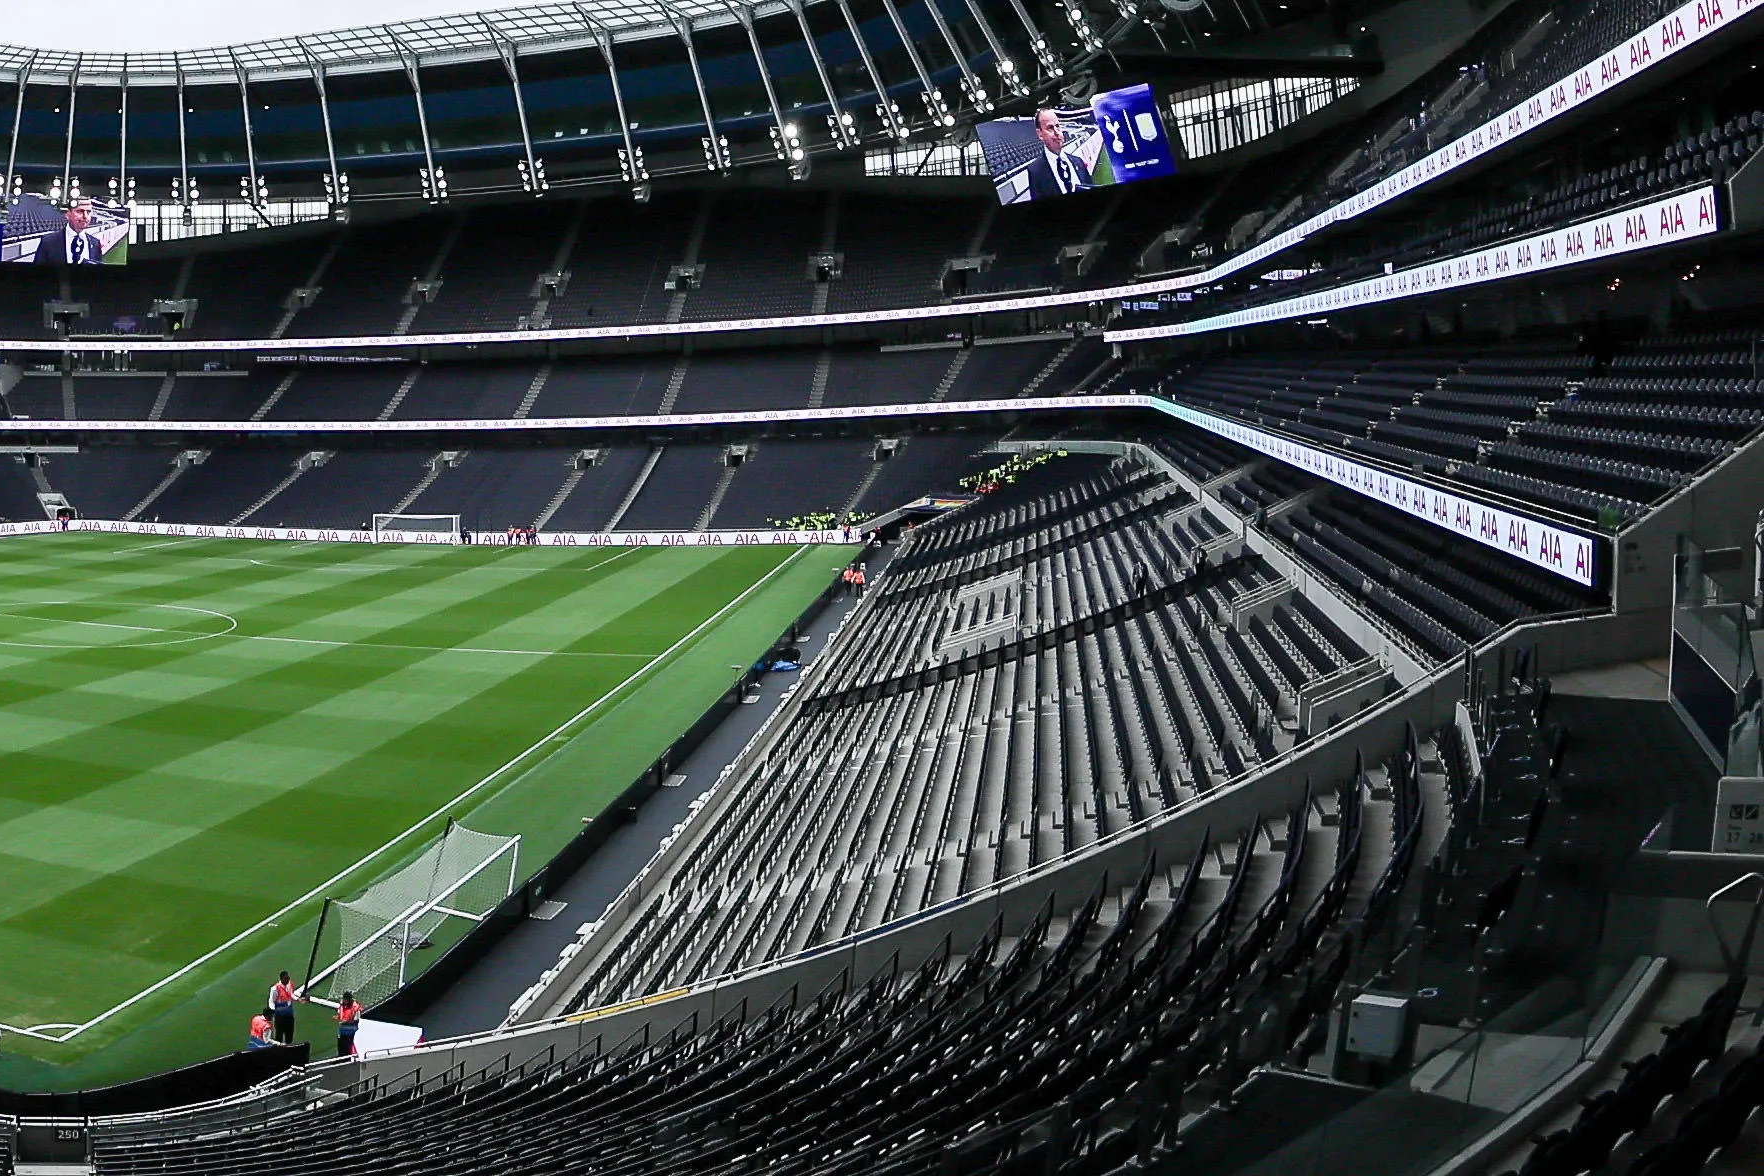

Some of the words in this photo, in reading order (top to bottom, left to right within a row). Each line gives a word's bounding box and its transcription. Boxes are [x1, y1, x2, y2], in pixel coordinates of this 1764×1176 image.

[1574, 70, 1592, 99] AIA
[1601, 54, 1620, 85] AIA
[1630, 36, 1651, 69] AIA
[1662, 16, 1685, 52] AIA
[1566, 230, 1584, 258] AIA
[1594, 222, 1614, 251] AIA
[1625, 213, 1647, 244] AIA
[1660, 202, 1685, 236] AIA
[24, 522, 41, 532] AIA
[79, 521, 101, 531] AIA
[110, 522, 128, 531] AIA
[138, 524, 156, 532] AIA
[166, 524, 185, 534] AIA
[195, 526, 215, 535] AIA
[225, 528, 245, 536] AIA
[255, 528, 276, 538] AIA
[286, 530, 307, 539] AIA
[317, 530, 339, 540] AIA
[350, 532, 371, 542] AIA
[383, 532, 404, 543] AIA
[416, 533, 437, 543] AIA
[483, 534, 506, 545] AIA
[552, 534, 576, 544] AIA
[588, 534, 612, 544] AIA
[624, 534, 648, 544] AIA
[660, 534, 685, 544] AIA
[697, 533, 721, 544] AIA
[734, 533, 759, 543] AIA
[772, 532, 797, 542] AIA
[809, 532, 835, 544] AIA
[1480, 510, 1498, 542] AIA
[1508, 519, 1528, 554] AIA
[1539, 530, 1562, 568] AIA
[58, 1129, 79, 1139] 250
